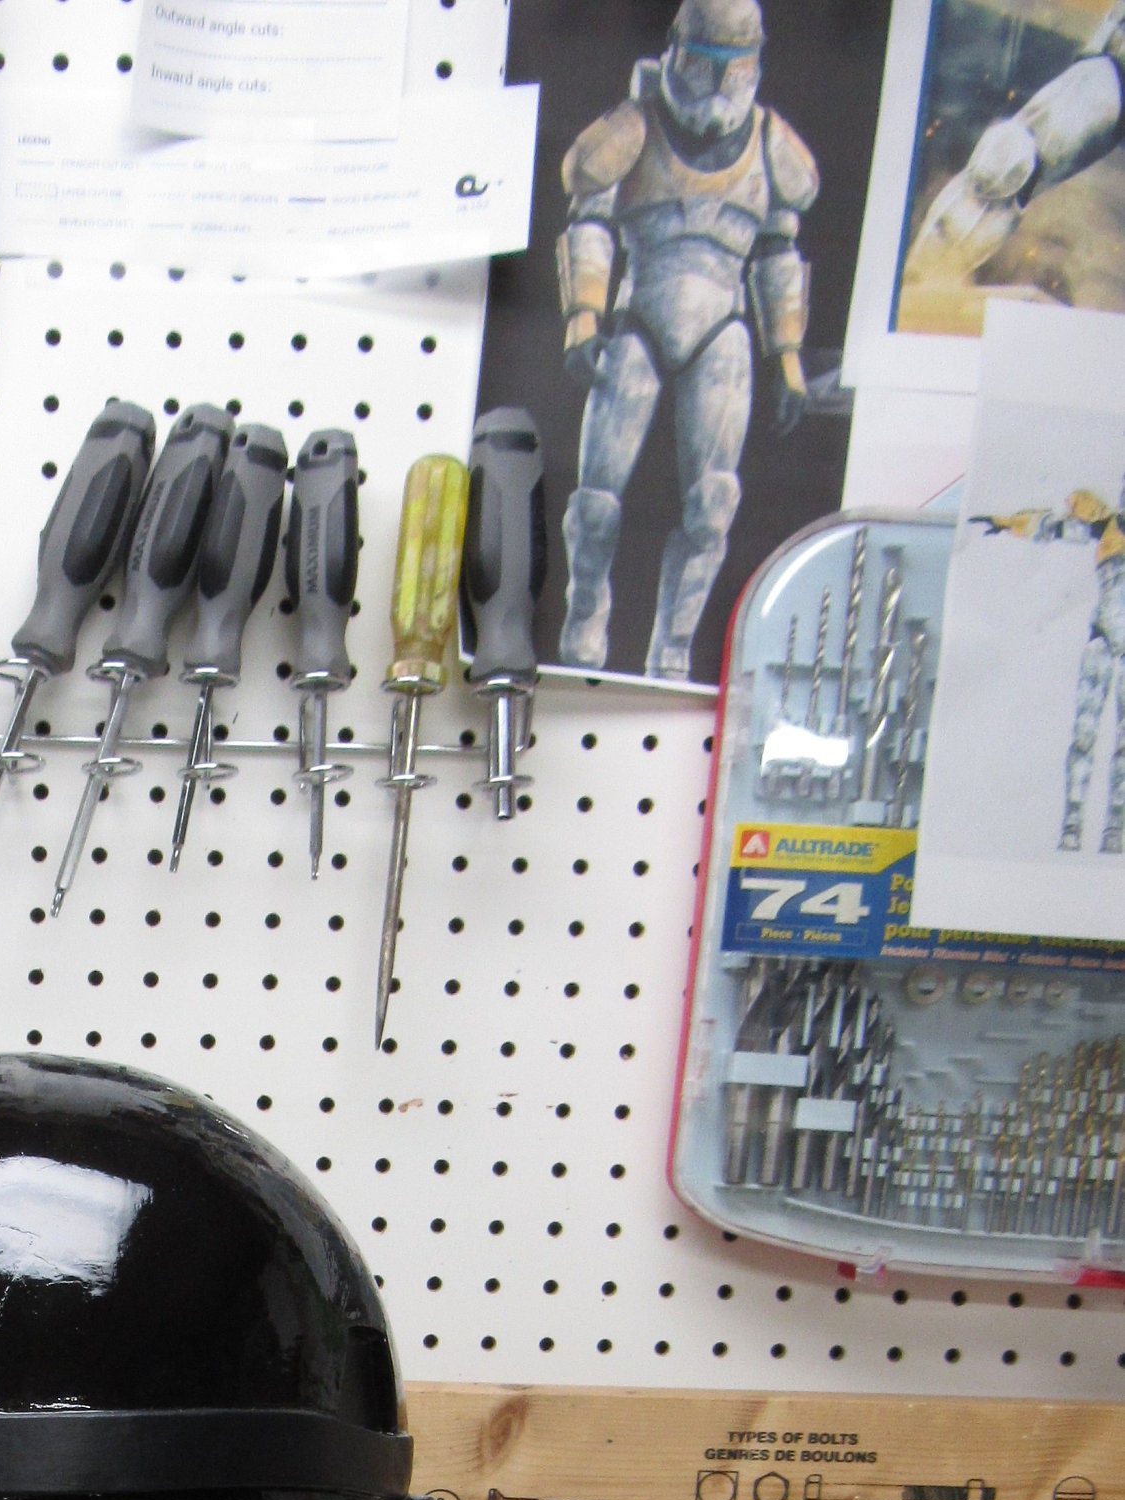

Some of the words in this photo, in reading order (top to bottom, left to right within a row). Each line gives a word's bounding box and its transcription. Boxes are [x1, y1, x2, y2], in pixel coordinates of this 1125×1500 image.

[155, 4, 205, 29] Outward
[209, 19, 246, 36] angle
[251, 23, 284, 36] cuts:
[151, 62, 193, 86] Inward
[197, 75, 233, 92] angle
[238, 79, 272, 92] cuts:
[776, 838, 874, 857] ALLTRADE
[740, 877, 870, 925] 74
[728, 1431, 777, 1443] TYPES
[782, 1432, 803, 1443] OF
[807, 1433, 859, 1445] BOLTS
[704, 1448, 769, 1460] GENRES
[774, 1449, 795, 1462] DE
[800, 1450, 877, 1463] BOULONS
